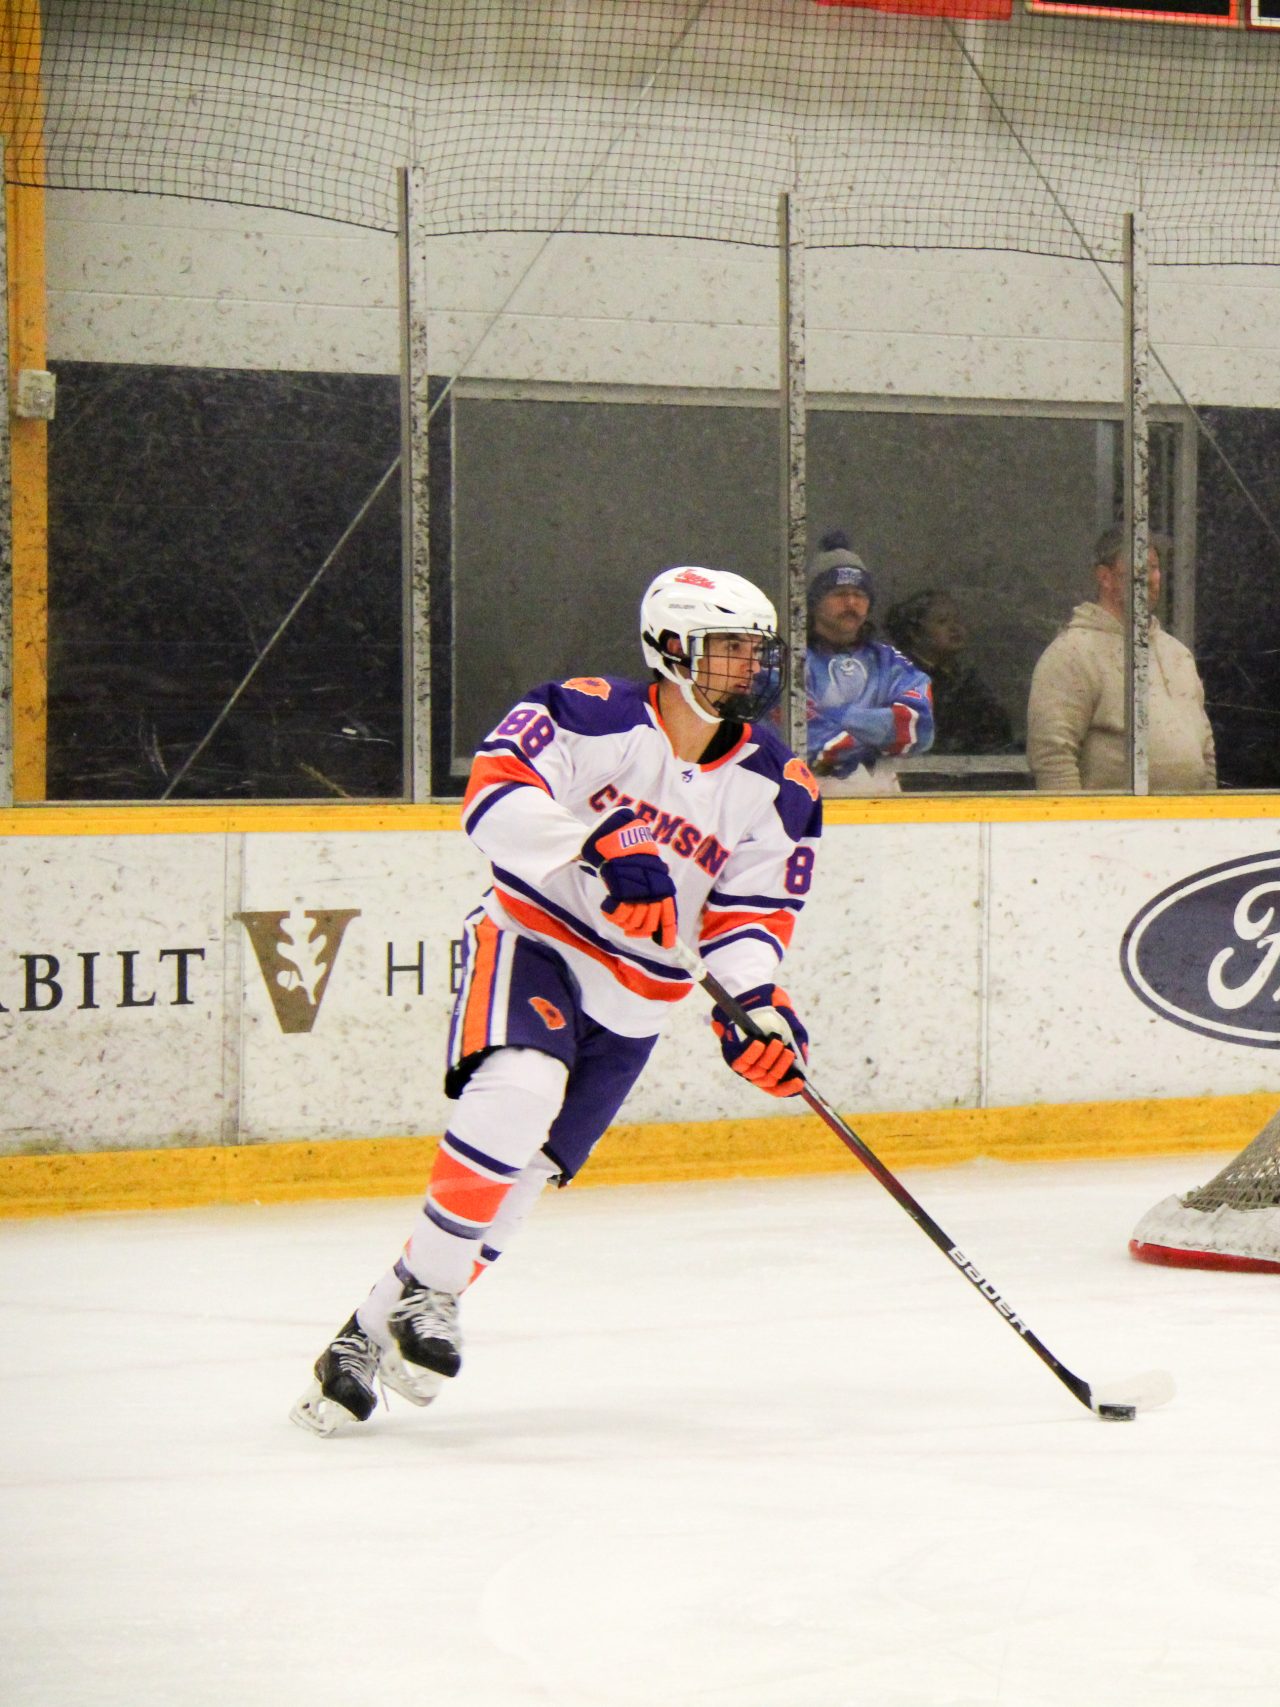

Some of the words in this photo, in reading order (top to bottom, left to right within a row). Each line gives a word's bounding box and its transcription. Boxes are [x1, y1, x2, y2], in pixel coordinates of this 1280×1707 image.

[496, 708, 555, 759] 88
[589, 783, 731, 878] CEMSN
[784, 846, 815, 895] 8
[0, 948, 205, 1013] BILT
[950, 1246, 1030, 1335] BAUER
